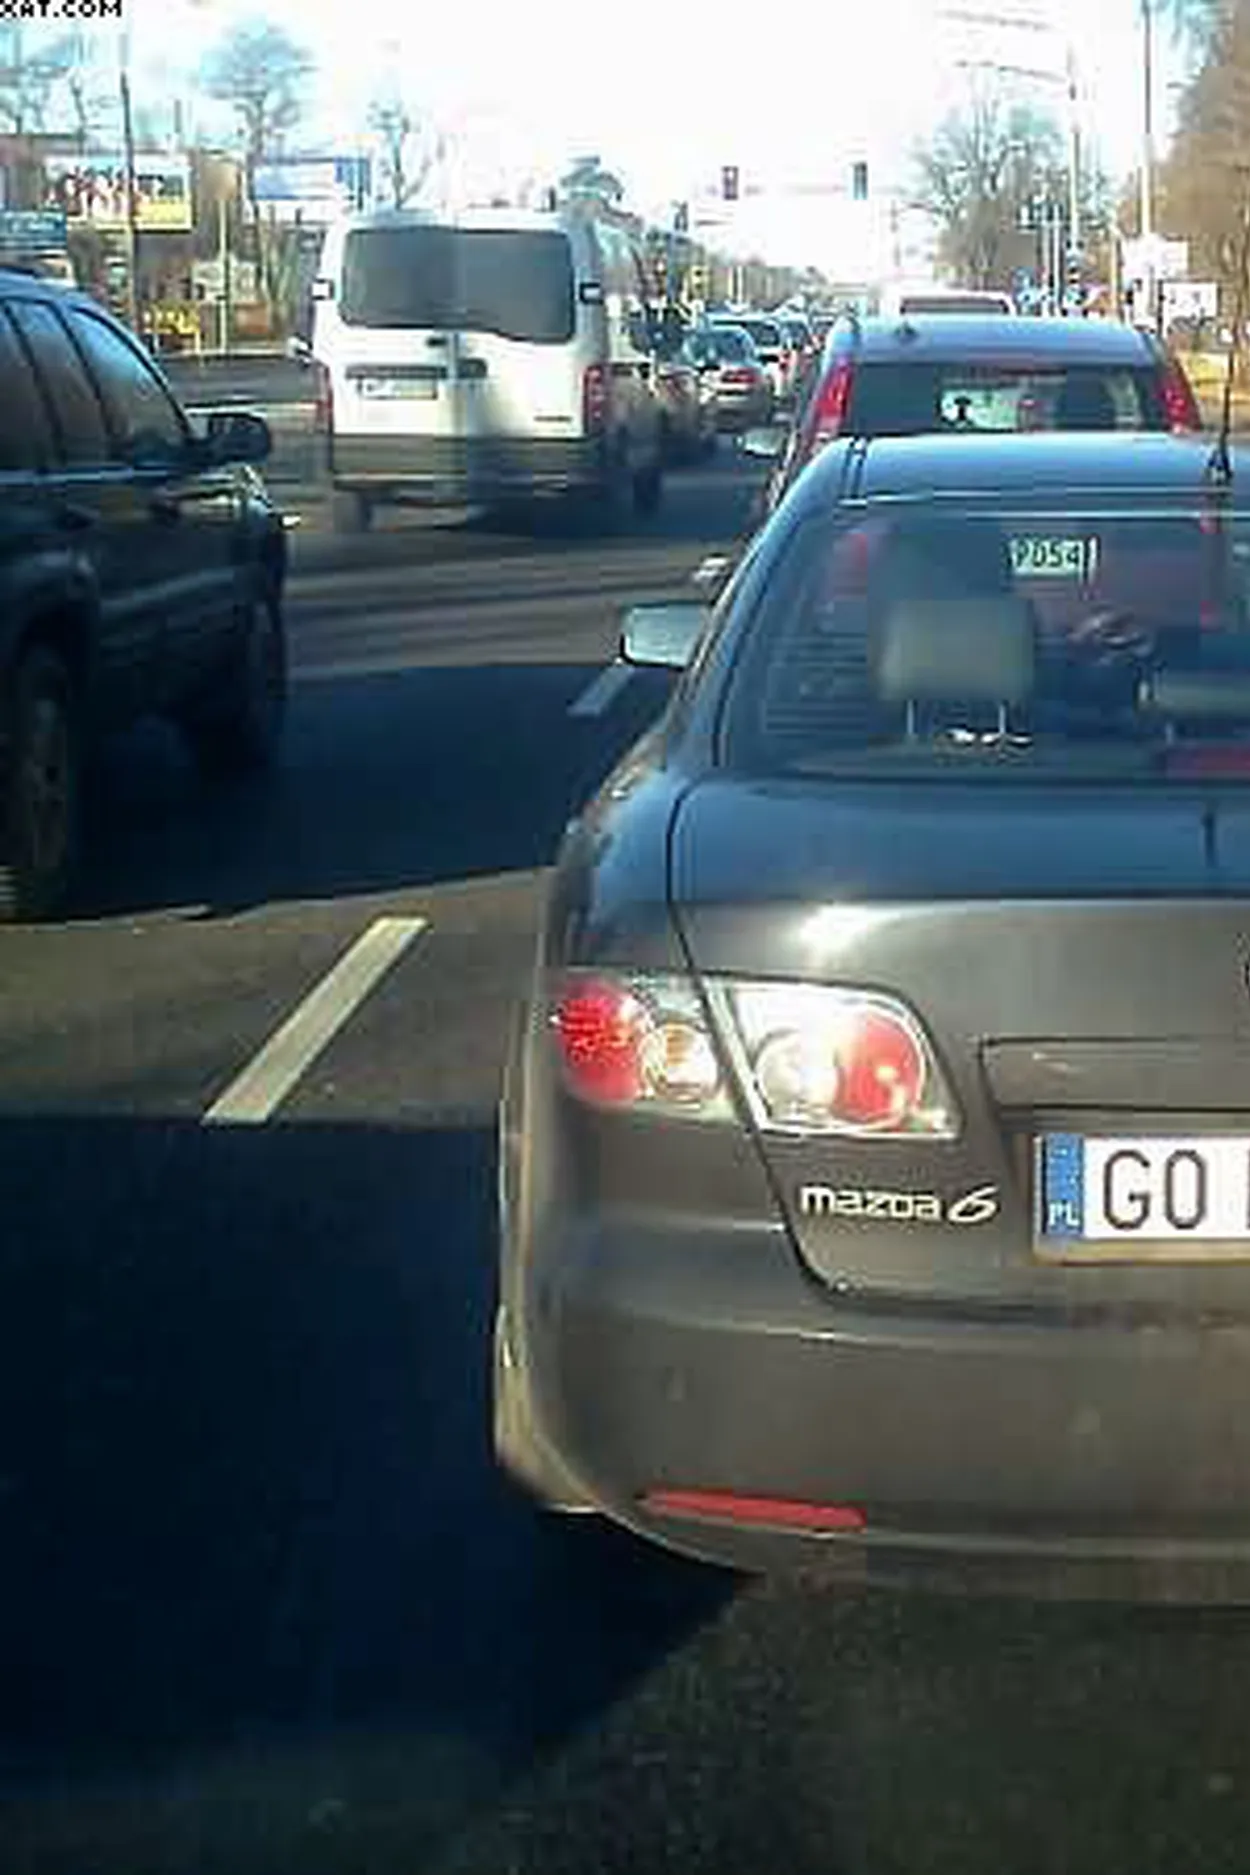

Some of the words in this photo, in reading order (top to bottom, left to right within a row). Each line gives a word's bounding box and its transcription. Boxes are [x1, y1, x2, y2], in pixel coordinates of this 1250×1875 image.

[799, 1185, 944, 1222] mazda
[948, 1185, 999, 1224] 6
[1048, 1202, 1081, 1227] PL
